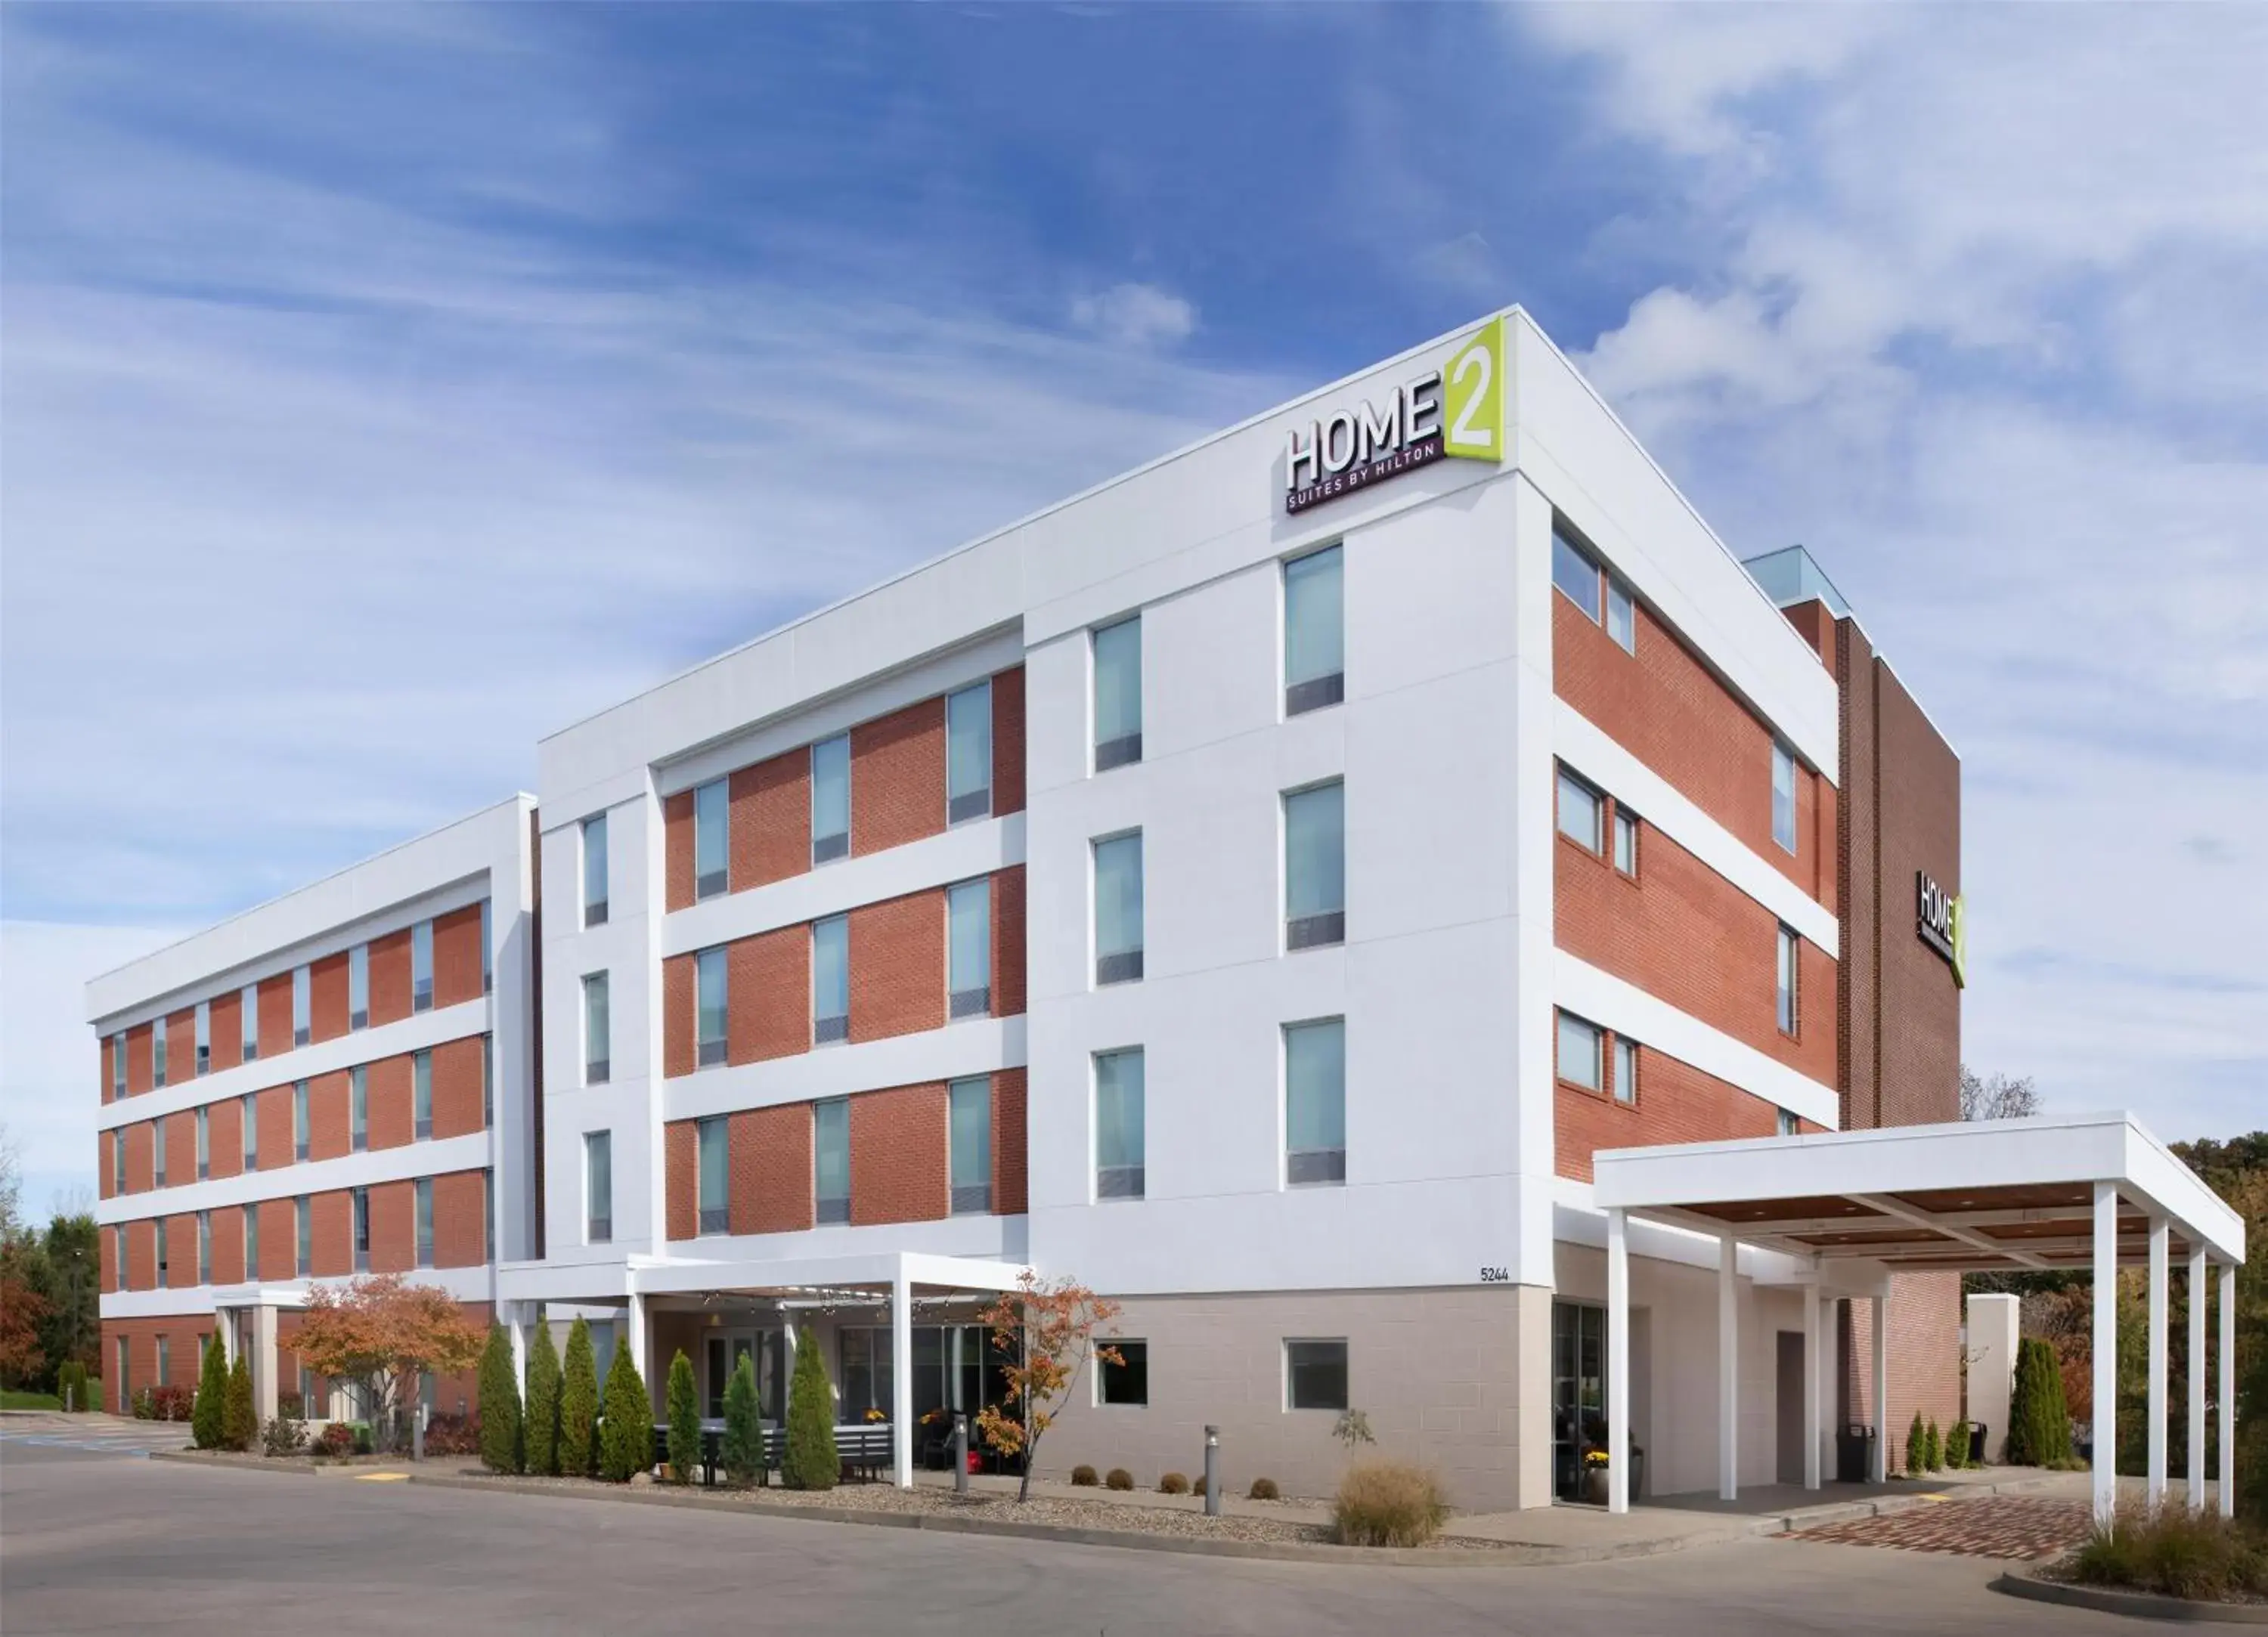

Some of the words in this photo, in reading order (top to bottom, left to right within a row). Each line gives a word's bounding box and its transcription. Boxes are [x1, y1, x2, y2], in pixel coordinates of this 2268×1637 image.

[1286, 370, 1441, 491] HOME
[1452, 345, 1492, 447] 2
[1288, 478, 1342, 509] SUITES
[1349, 469, 1368, 485] BY
[1376, 443, 1434, 475] HILTON
[1921, 871, 1954, 945] HOME
[1481, 1267, 1508, 1281] 5244
